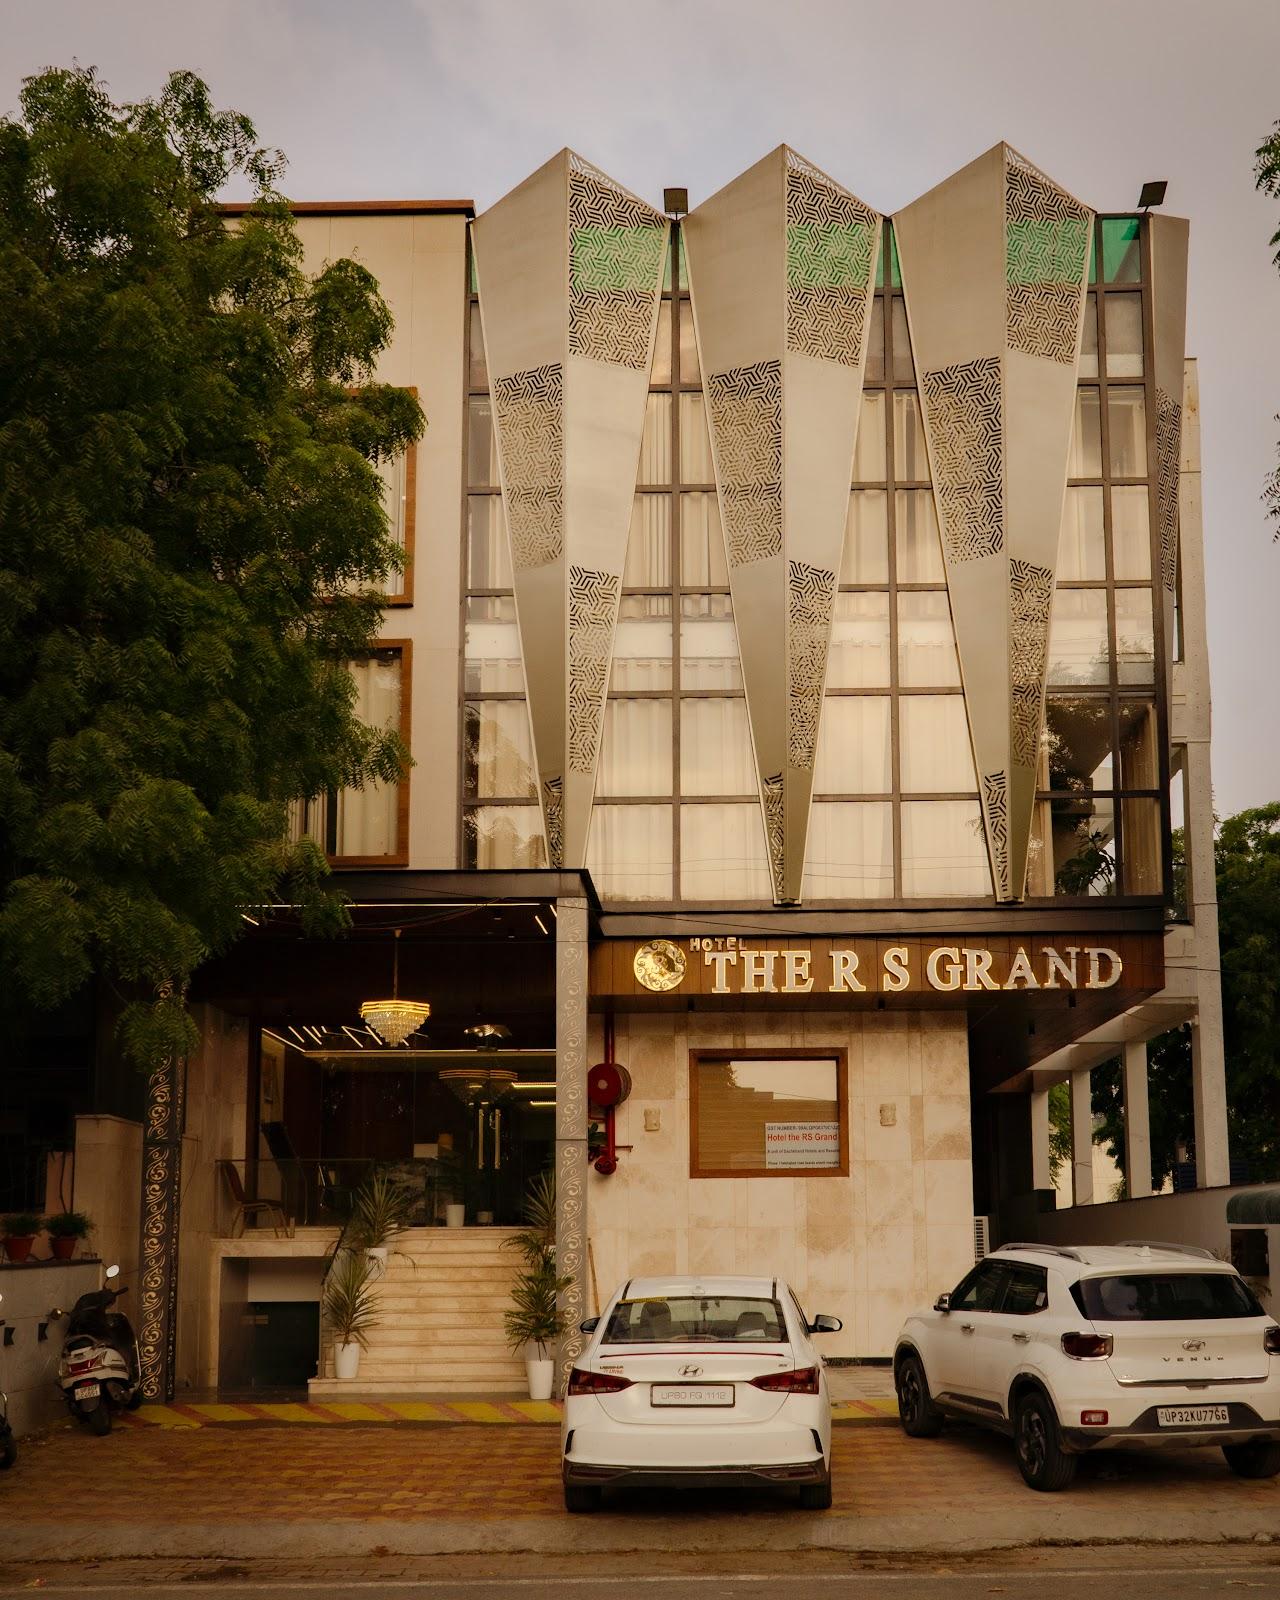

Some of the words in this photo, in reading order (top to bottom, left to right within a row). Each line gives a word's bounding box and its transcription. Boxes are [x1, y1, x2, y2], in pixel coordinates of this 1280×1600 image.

[690, 937, 747, 951] HOTEL
[705, 950, 814, 993] THE
[829, 950, 866, 992] R
[883, 947, 910, 991] S
[926, 946, 1122, 991] GRAND
[767, 1133, 787, 1141] Hotel
[802, 1133, 813, 1141] RS
[815, 1133, 838, 1141] Grand
[1165, 1409, 1227, 1423] UP32KU7766
